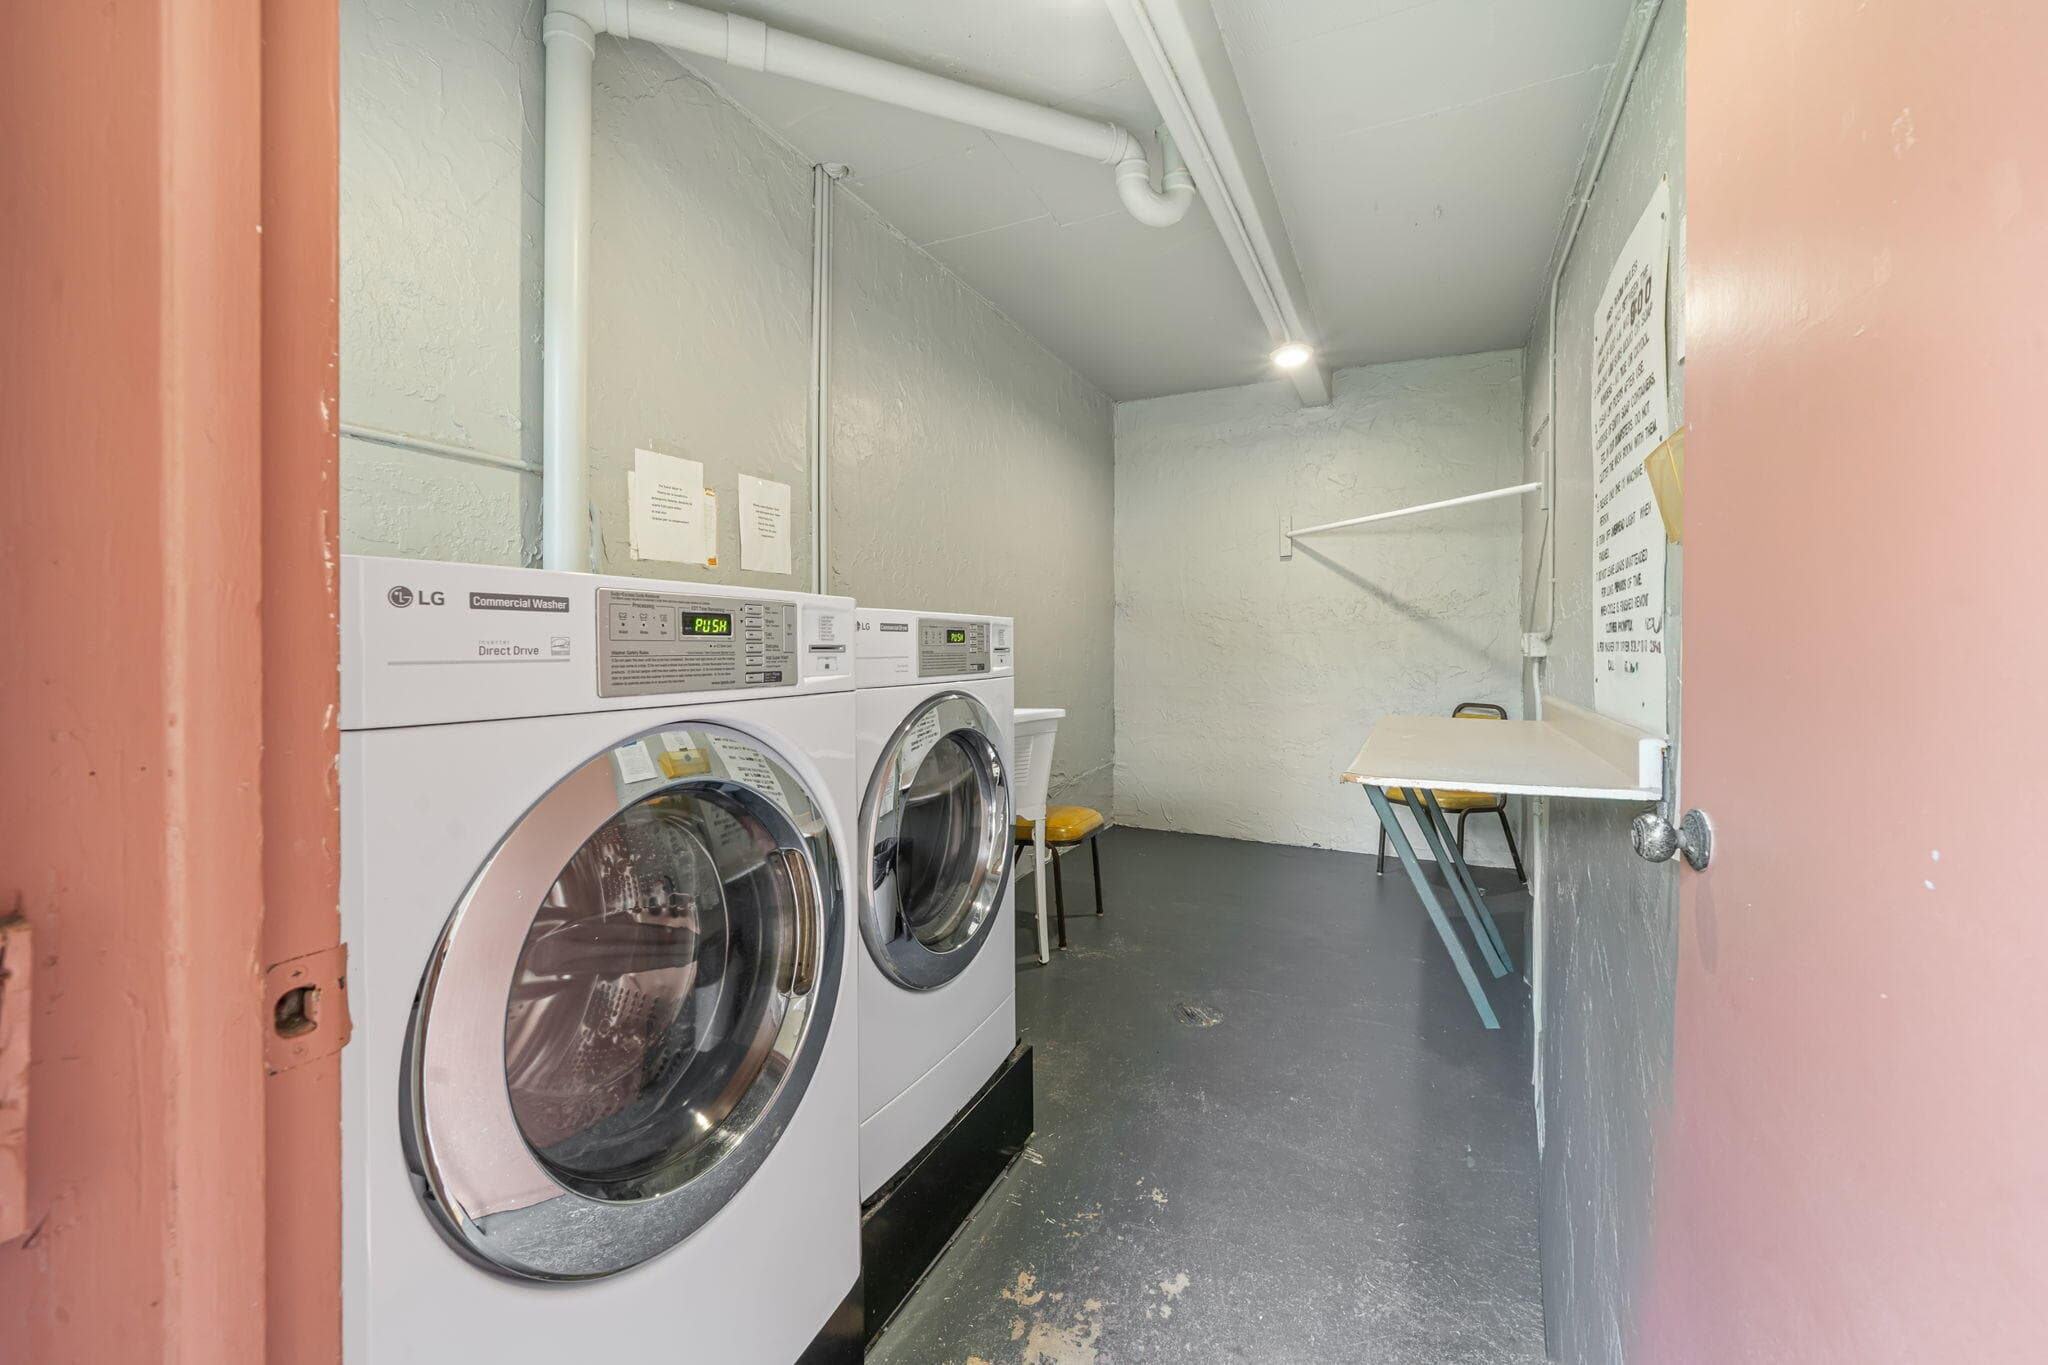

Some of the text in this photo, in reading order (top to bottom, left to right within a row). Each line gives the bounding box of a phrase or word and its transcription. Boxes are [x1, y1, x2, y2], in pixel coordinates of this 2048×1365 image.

[418, 590, 446, 606] LG
[472, 595, 568, 611] Commercial Washer
[695, 618, 728, 633] PUSH
[861, 622, 871, 631] LG
[479, 645, 511, 656] Direct
[513, 645, 539, 656] Drive
